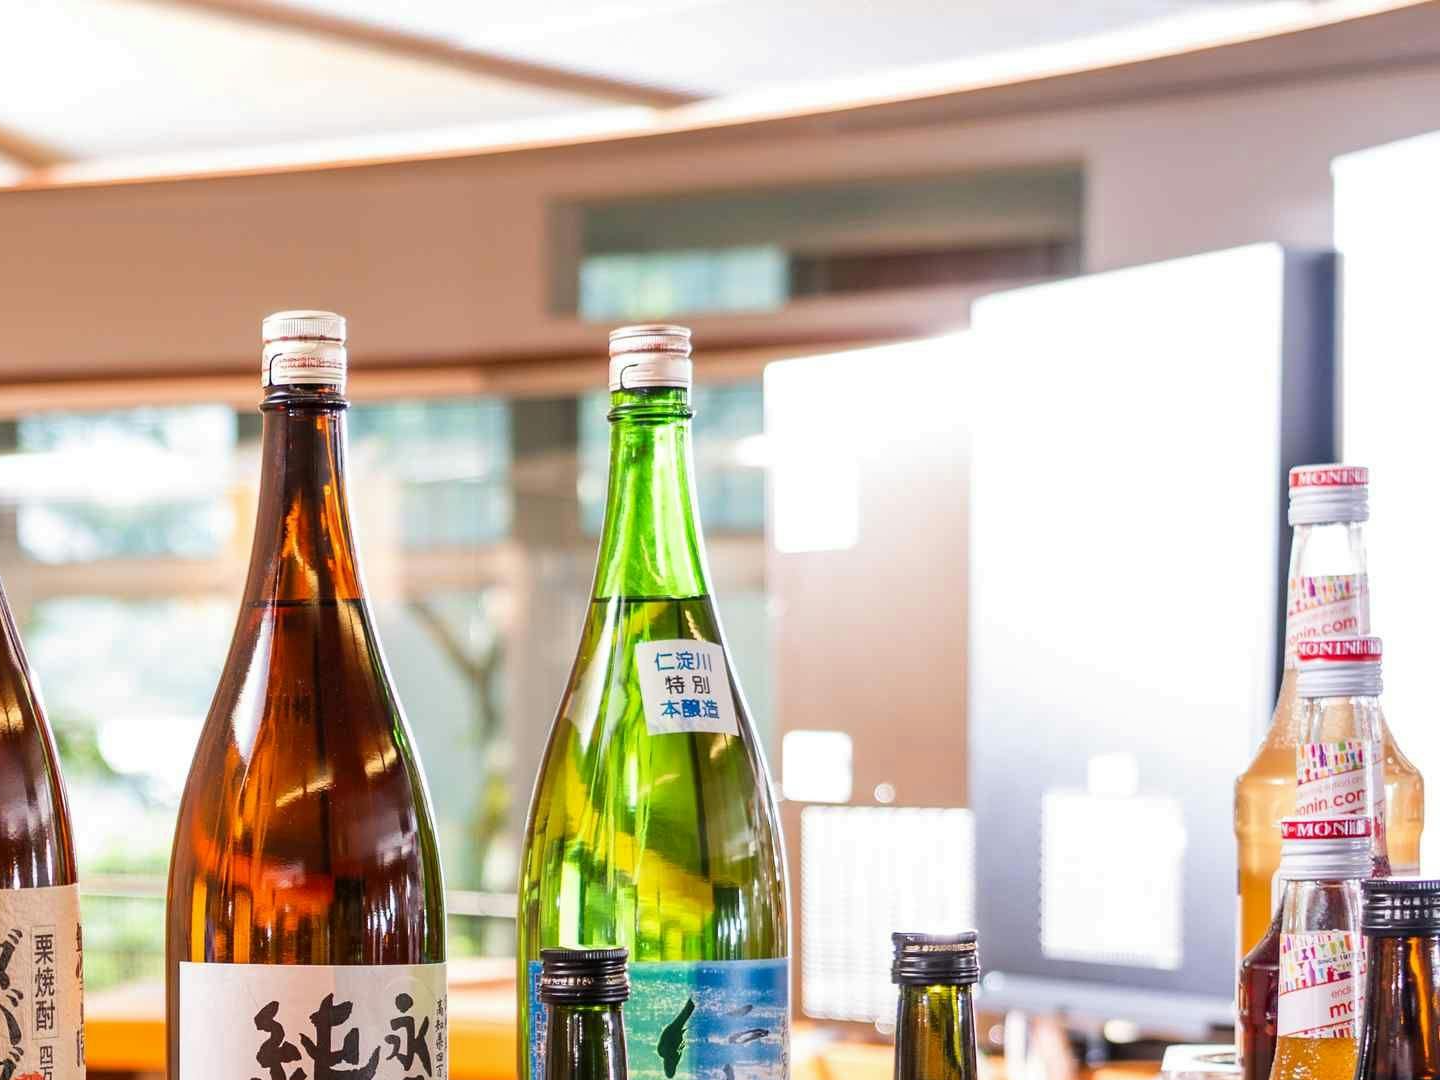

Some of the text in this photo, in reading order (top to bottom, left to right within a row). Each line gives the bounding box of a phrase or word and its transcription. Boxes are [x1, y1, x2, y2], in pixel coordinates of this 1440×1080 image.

[654, 651, 712, 672] 仁淀川
[665, 676, 710, 694] 特別
[660, 699, 720, 719] 本醸造
[34, 934, 56, 1033] 栗焼酎
